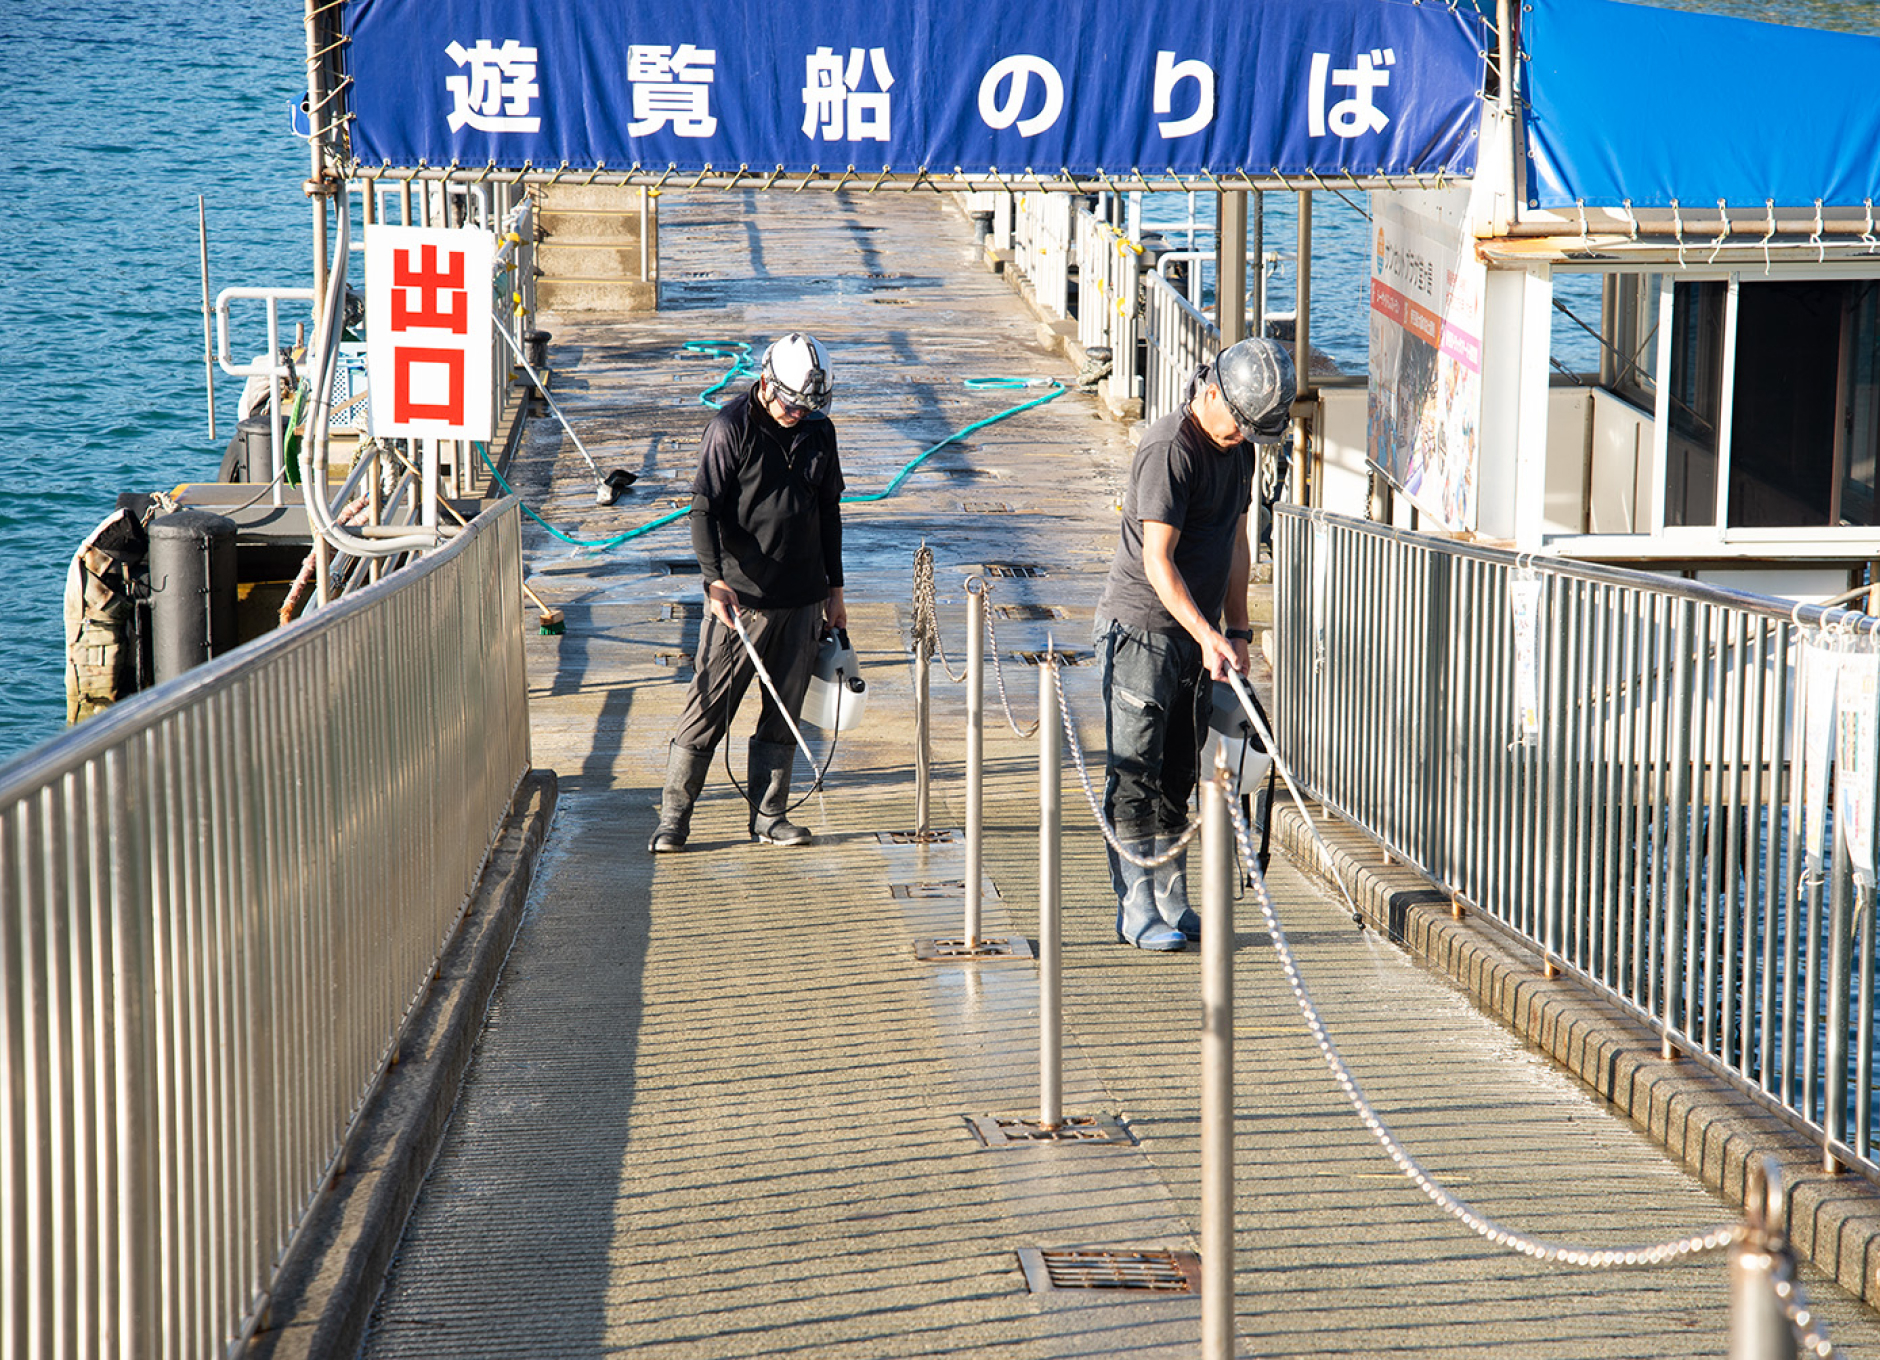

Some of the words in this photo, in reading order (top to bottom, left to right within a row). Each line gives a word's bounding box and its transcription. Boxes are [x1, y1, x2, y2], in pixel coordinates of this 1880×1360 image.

[444, 39, 1396, 142] 遊覧船のりば
[391, 244, 468, 426] 出口
